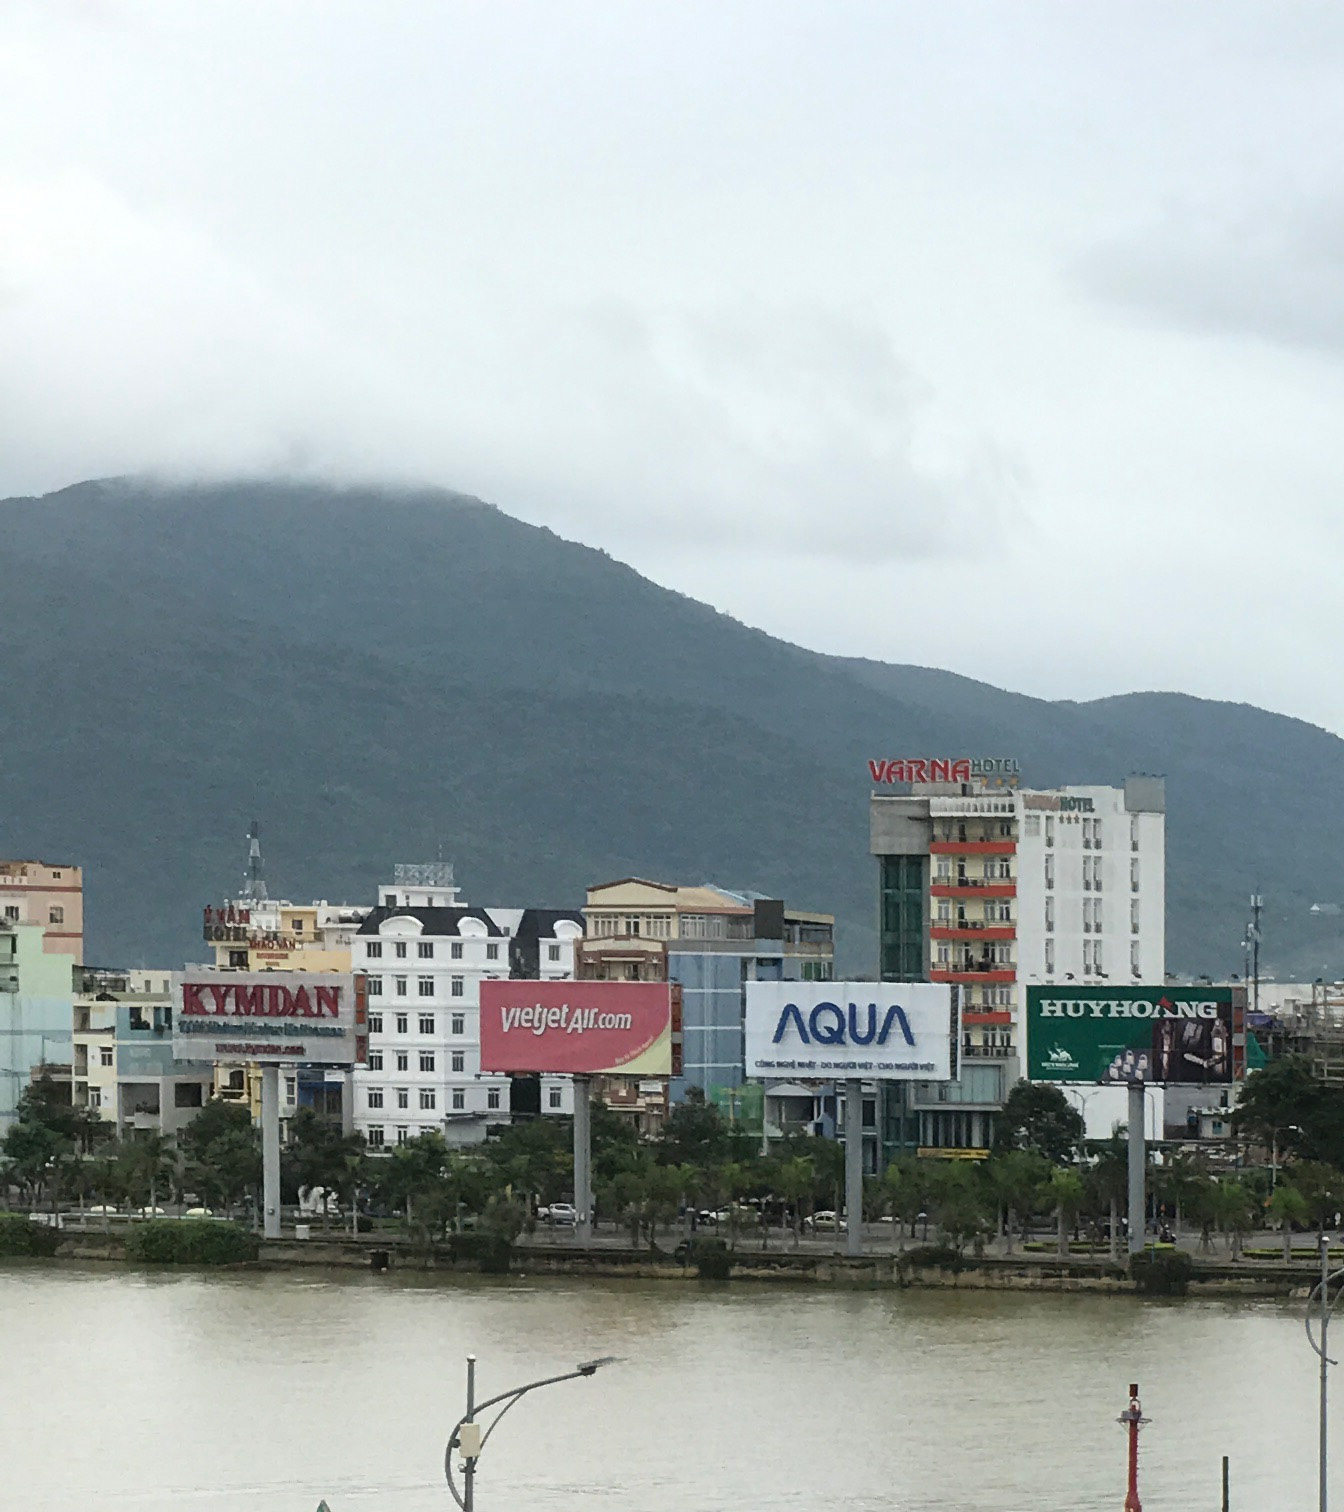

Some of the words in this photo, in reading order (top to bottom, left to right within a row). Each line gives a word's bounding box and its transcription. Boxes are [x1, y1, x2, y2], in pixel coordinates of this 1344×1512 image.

[868, 759, 970, 783] VARNA
[971, 759, 1020, 773] HOTEL
[180, 983, 341, 1018] KYMDAN
[772, 1001, 915, 1046] AQUA
